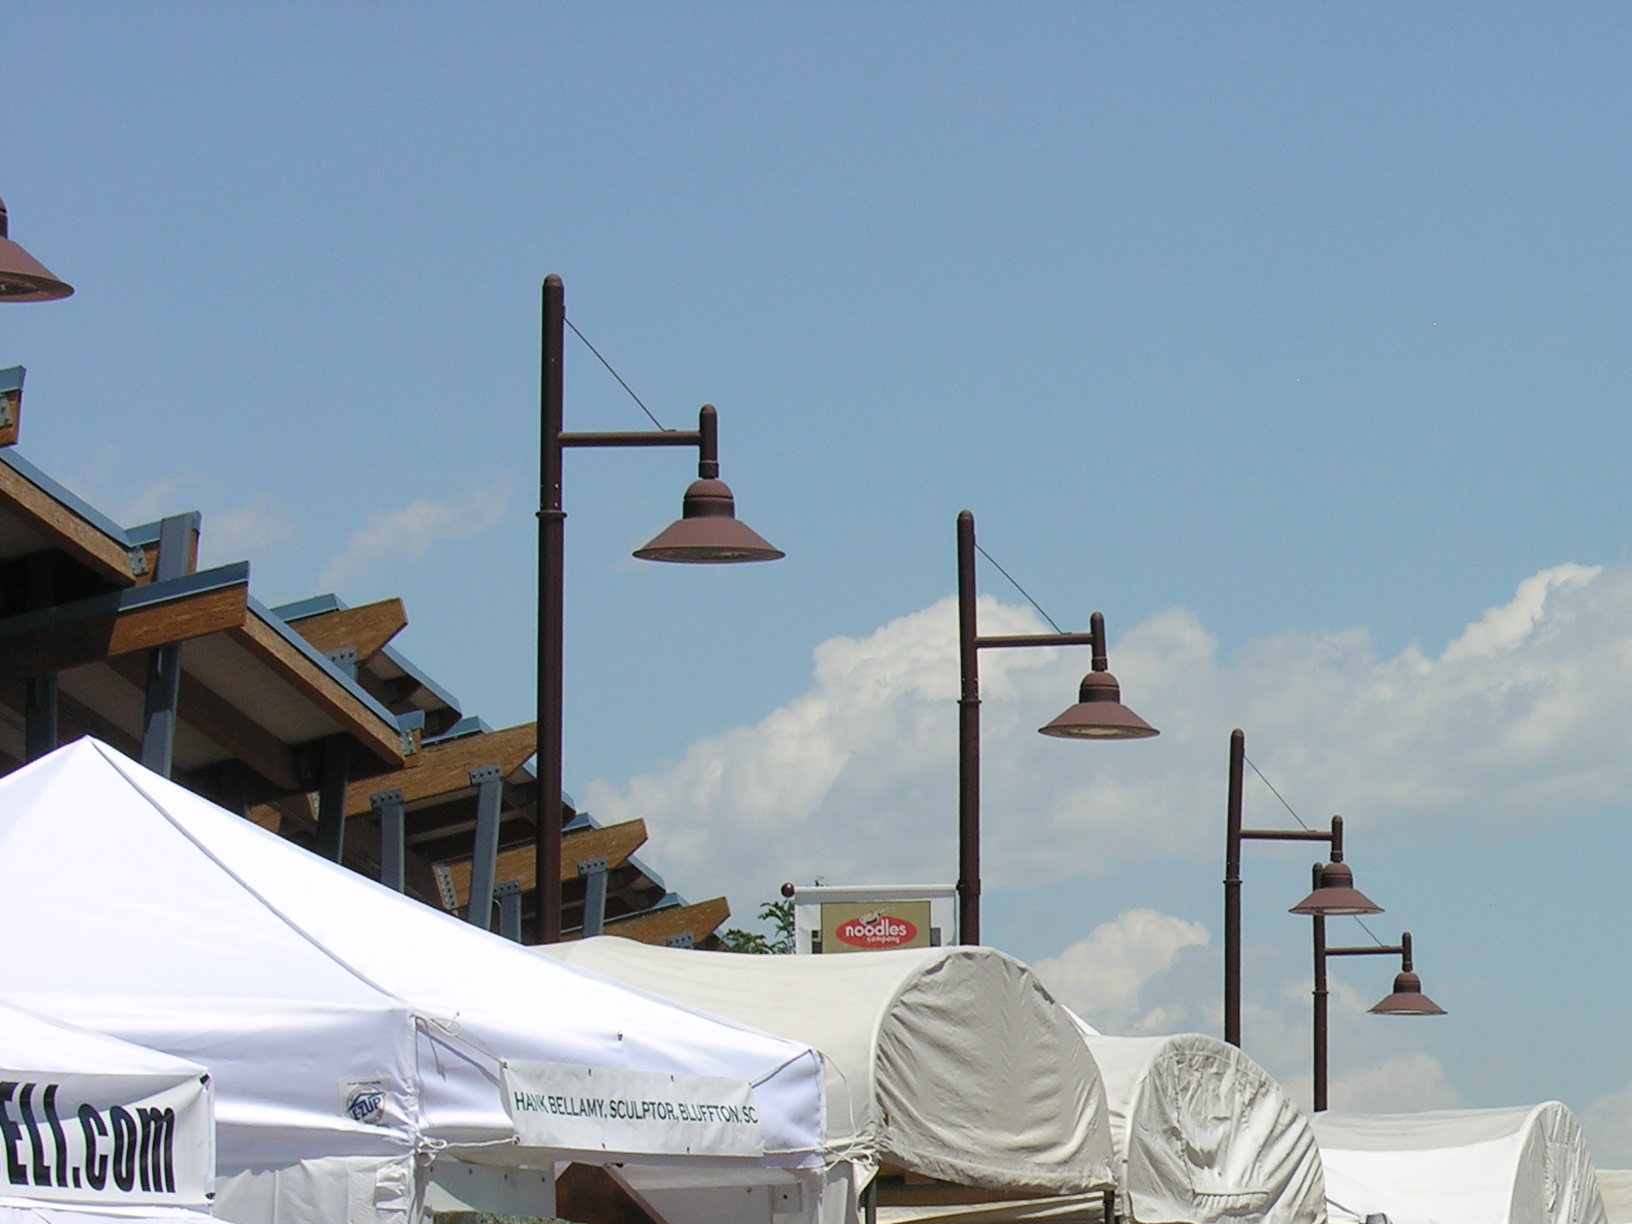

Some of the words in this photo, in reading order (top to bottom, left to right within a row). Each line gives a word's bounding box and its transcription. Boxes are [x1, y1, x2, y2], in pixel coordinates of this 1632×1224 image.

[845, 918, 908, 937] noodles
[514, 1091, 549, 1114] HANK
[547, 1095, 608, 1120] BELLAMY,
[610, 1100, 680, 1123] SCULPTOR,
[742, 1106, 759, 1124] SC
